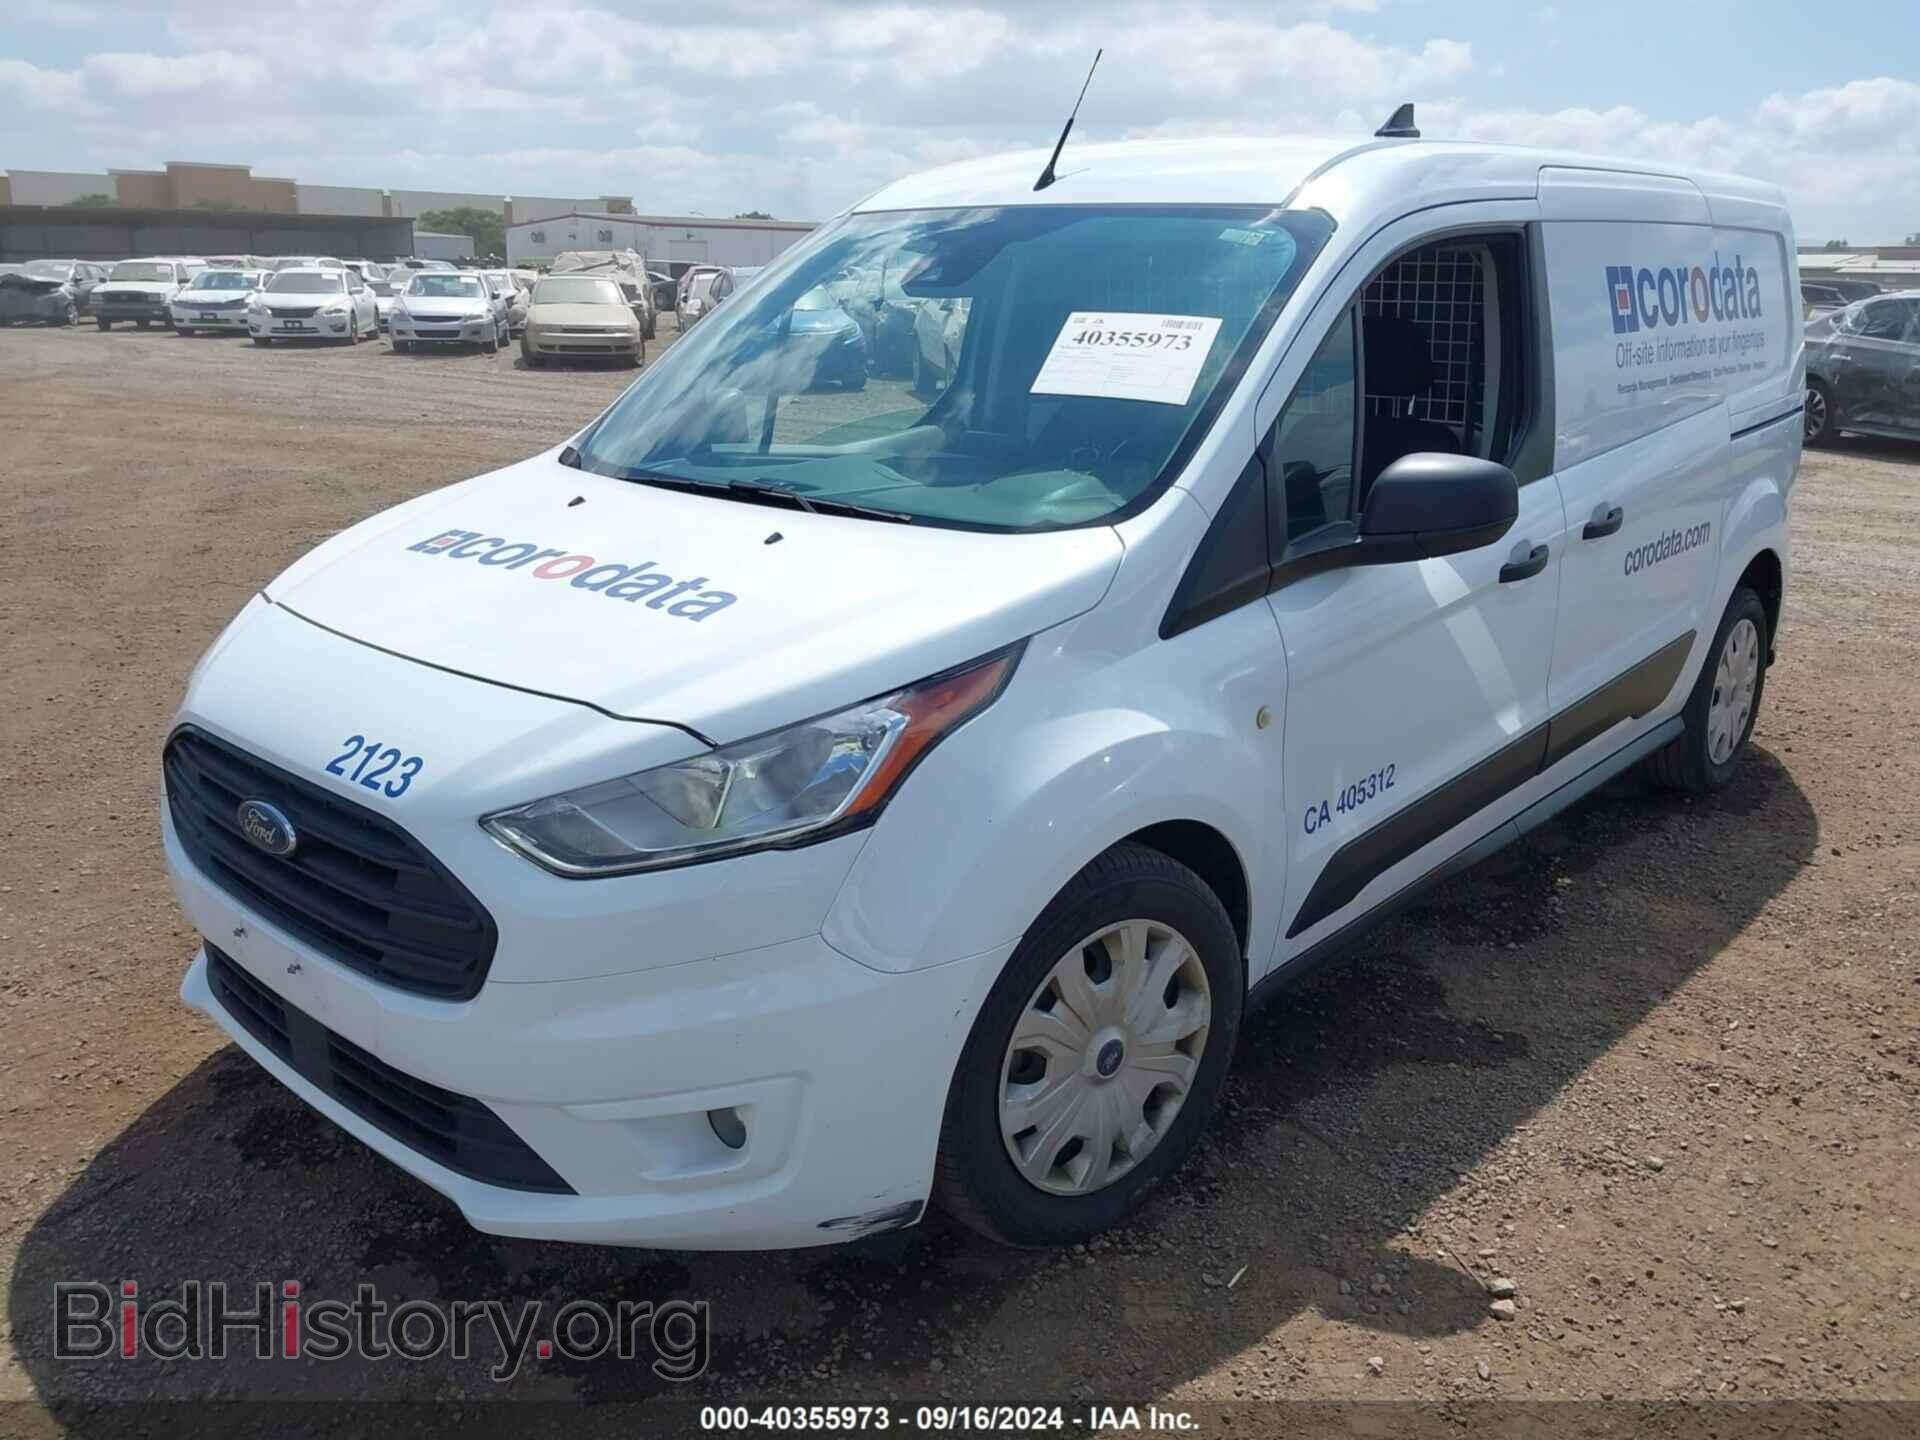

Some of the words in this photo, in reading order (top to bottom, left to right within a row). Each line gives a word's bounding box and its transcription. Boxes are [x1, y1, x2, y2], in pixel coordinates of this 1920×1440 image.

[1637, 251, 1762, 328] corodata
[1072, 330, 1192, 351] 40355973
[1616, 341, 1654, 369] Off-site
[1624, 521, 1711, 576] corodata.com
[447, 537, 738, 622] corodata
[325, 735, 423, 798] 2123
[244, 808, 277, 845] Ford
[1304, 800, 1331, 834] CA
[1336, 763, 1395, 814] 405312
